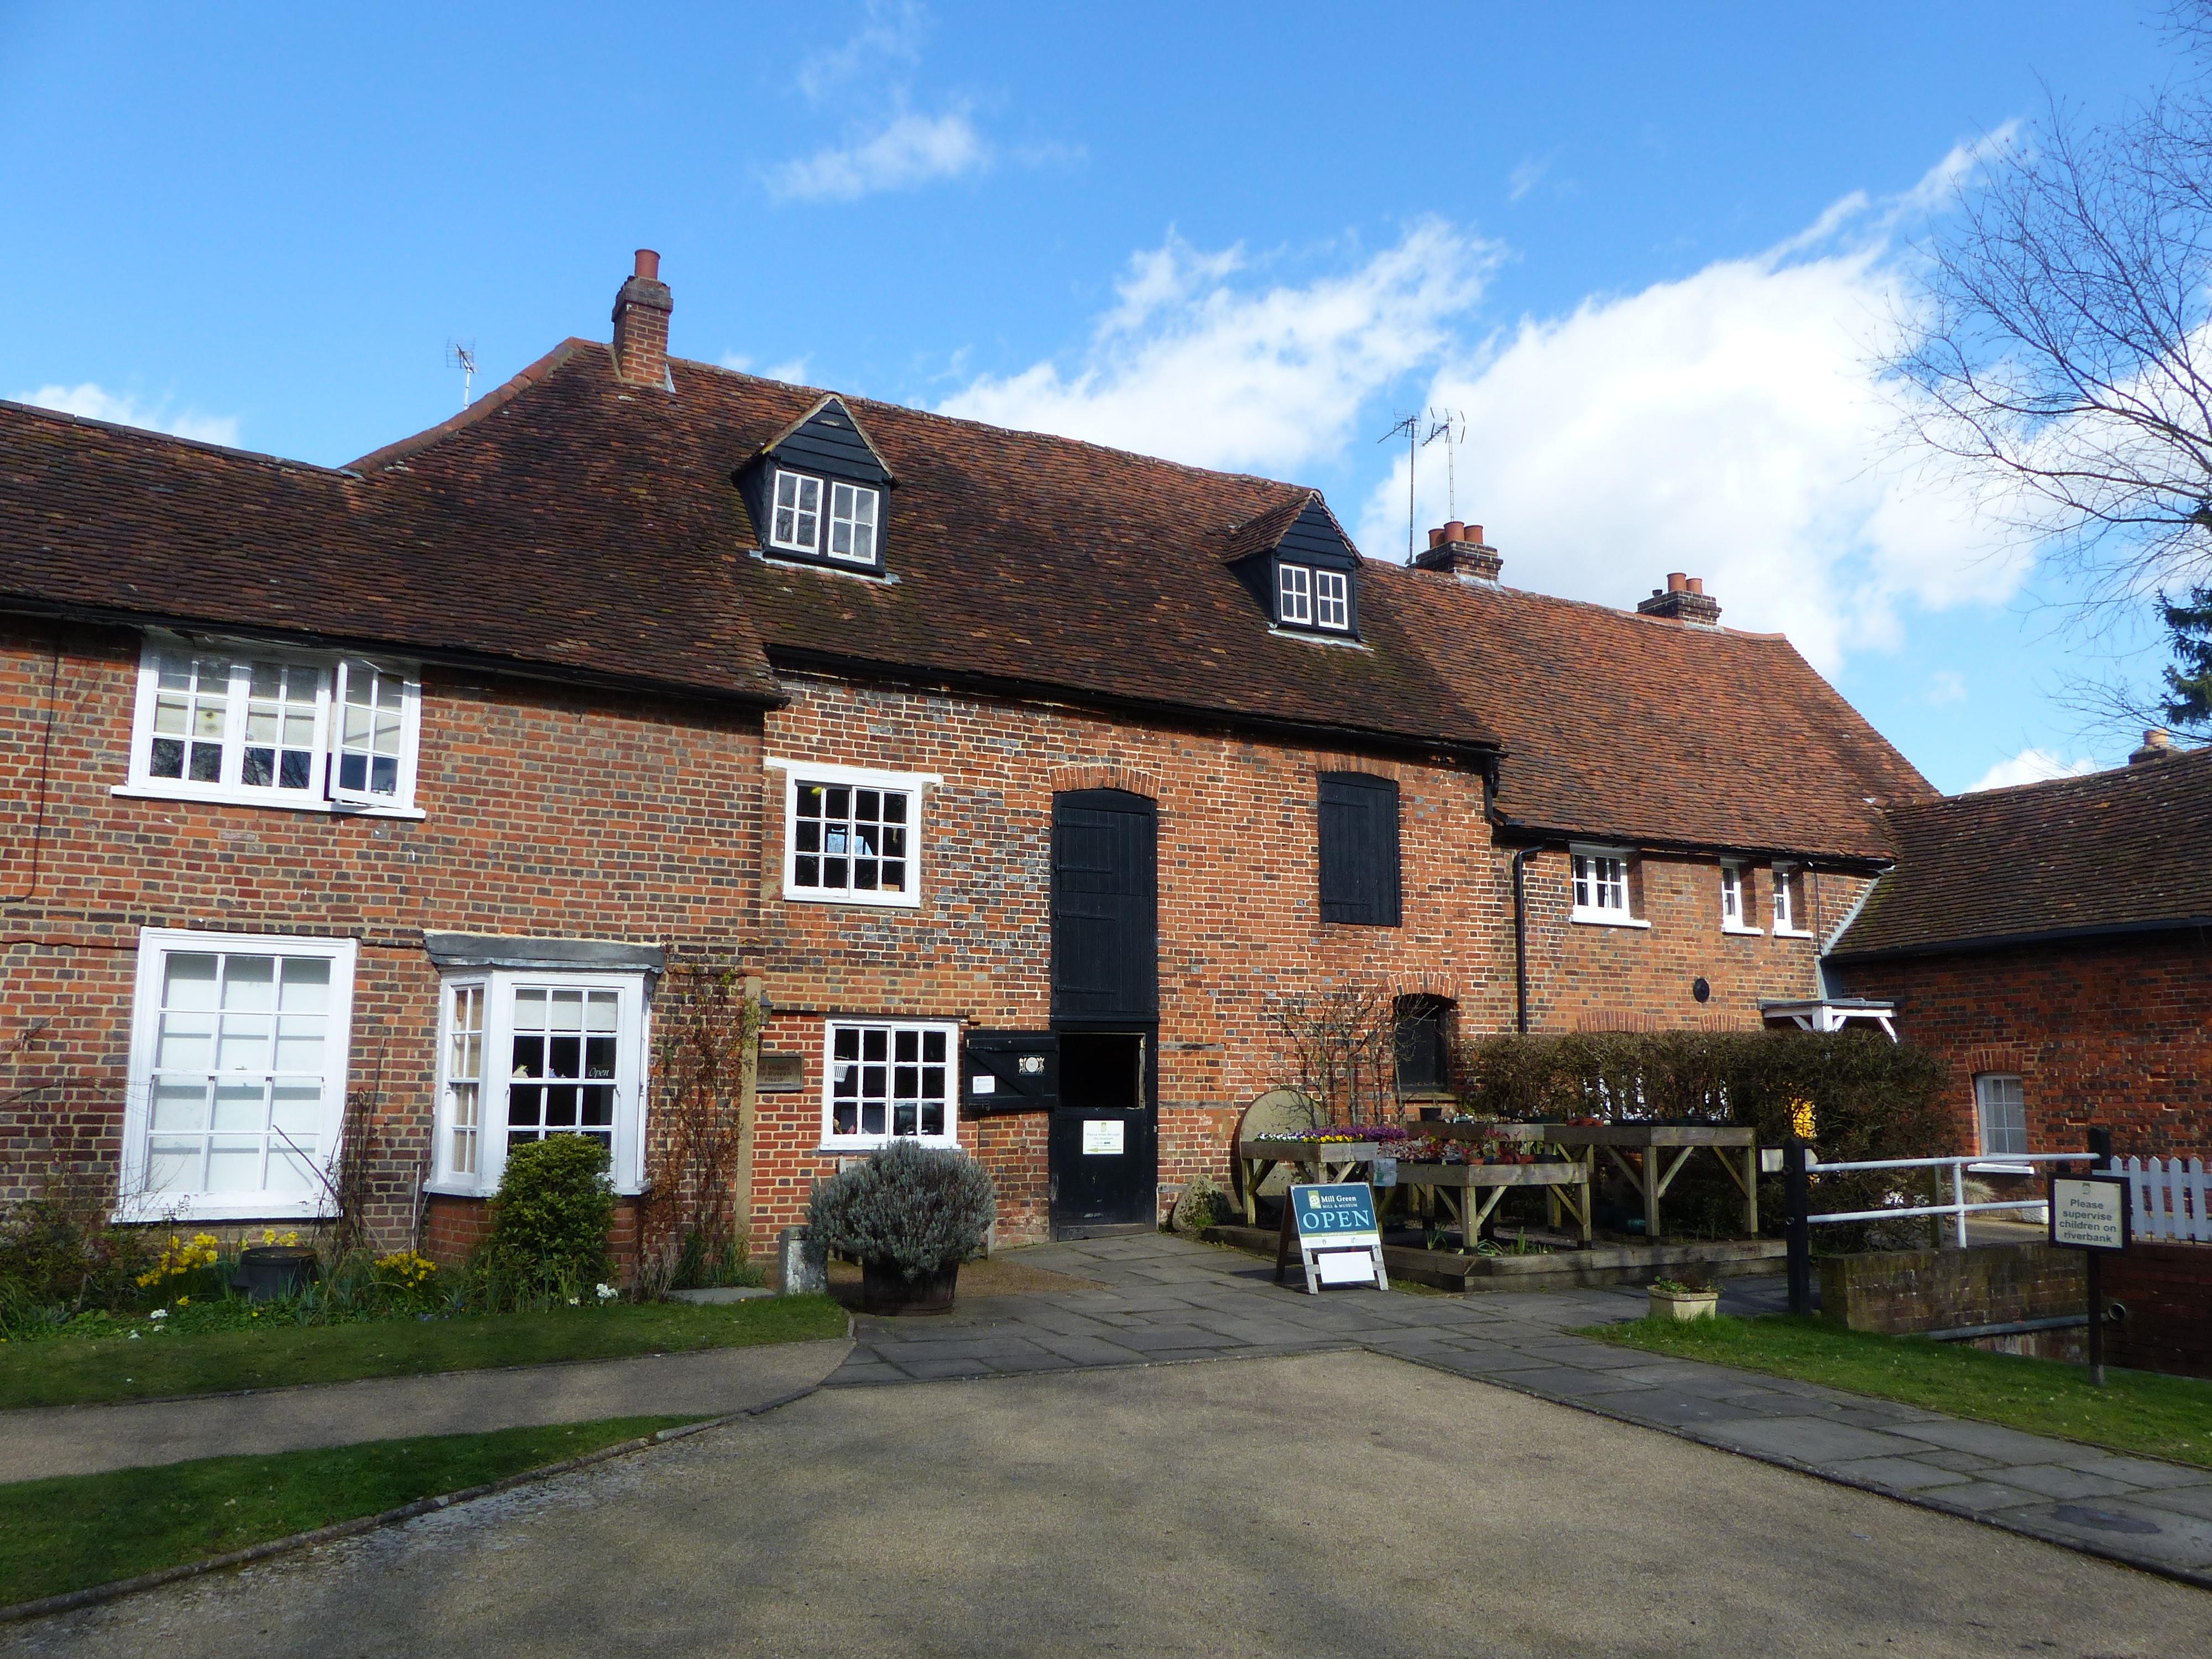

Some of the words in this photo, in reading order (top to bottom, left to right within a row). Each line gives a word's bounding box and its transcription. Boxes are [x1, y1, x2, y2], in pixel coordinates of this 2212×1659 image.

[589, 1067, 609, 1078] Open
[2070, 1199, 2104, 1209] Please
[1302, 1210, 1370, 1229] OPEN
[2063, 1211, 2112, 1220] supervise
[2059, 1220, 2100, 1230] children
[2064, 1231, 2112, 1242] riverbank
